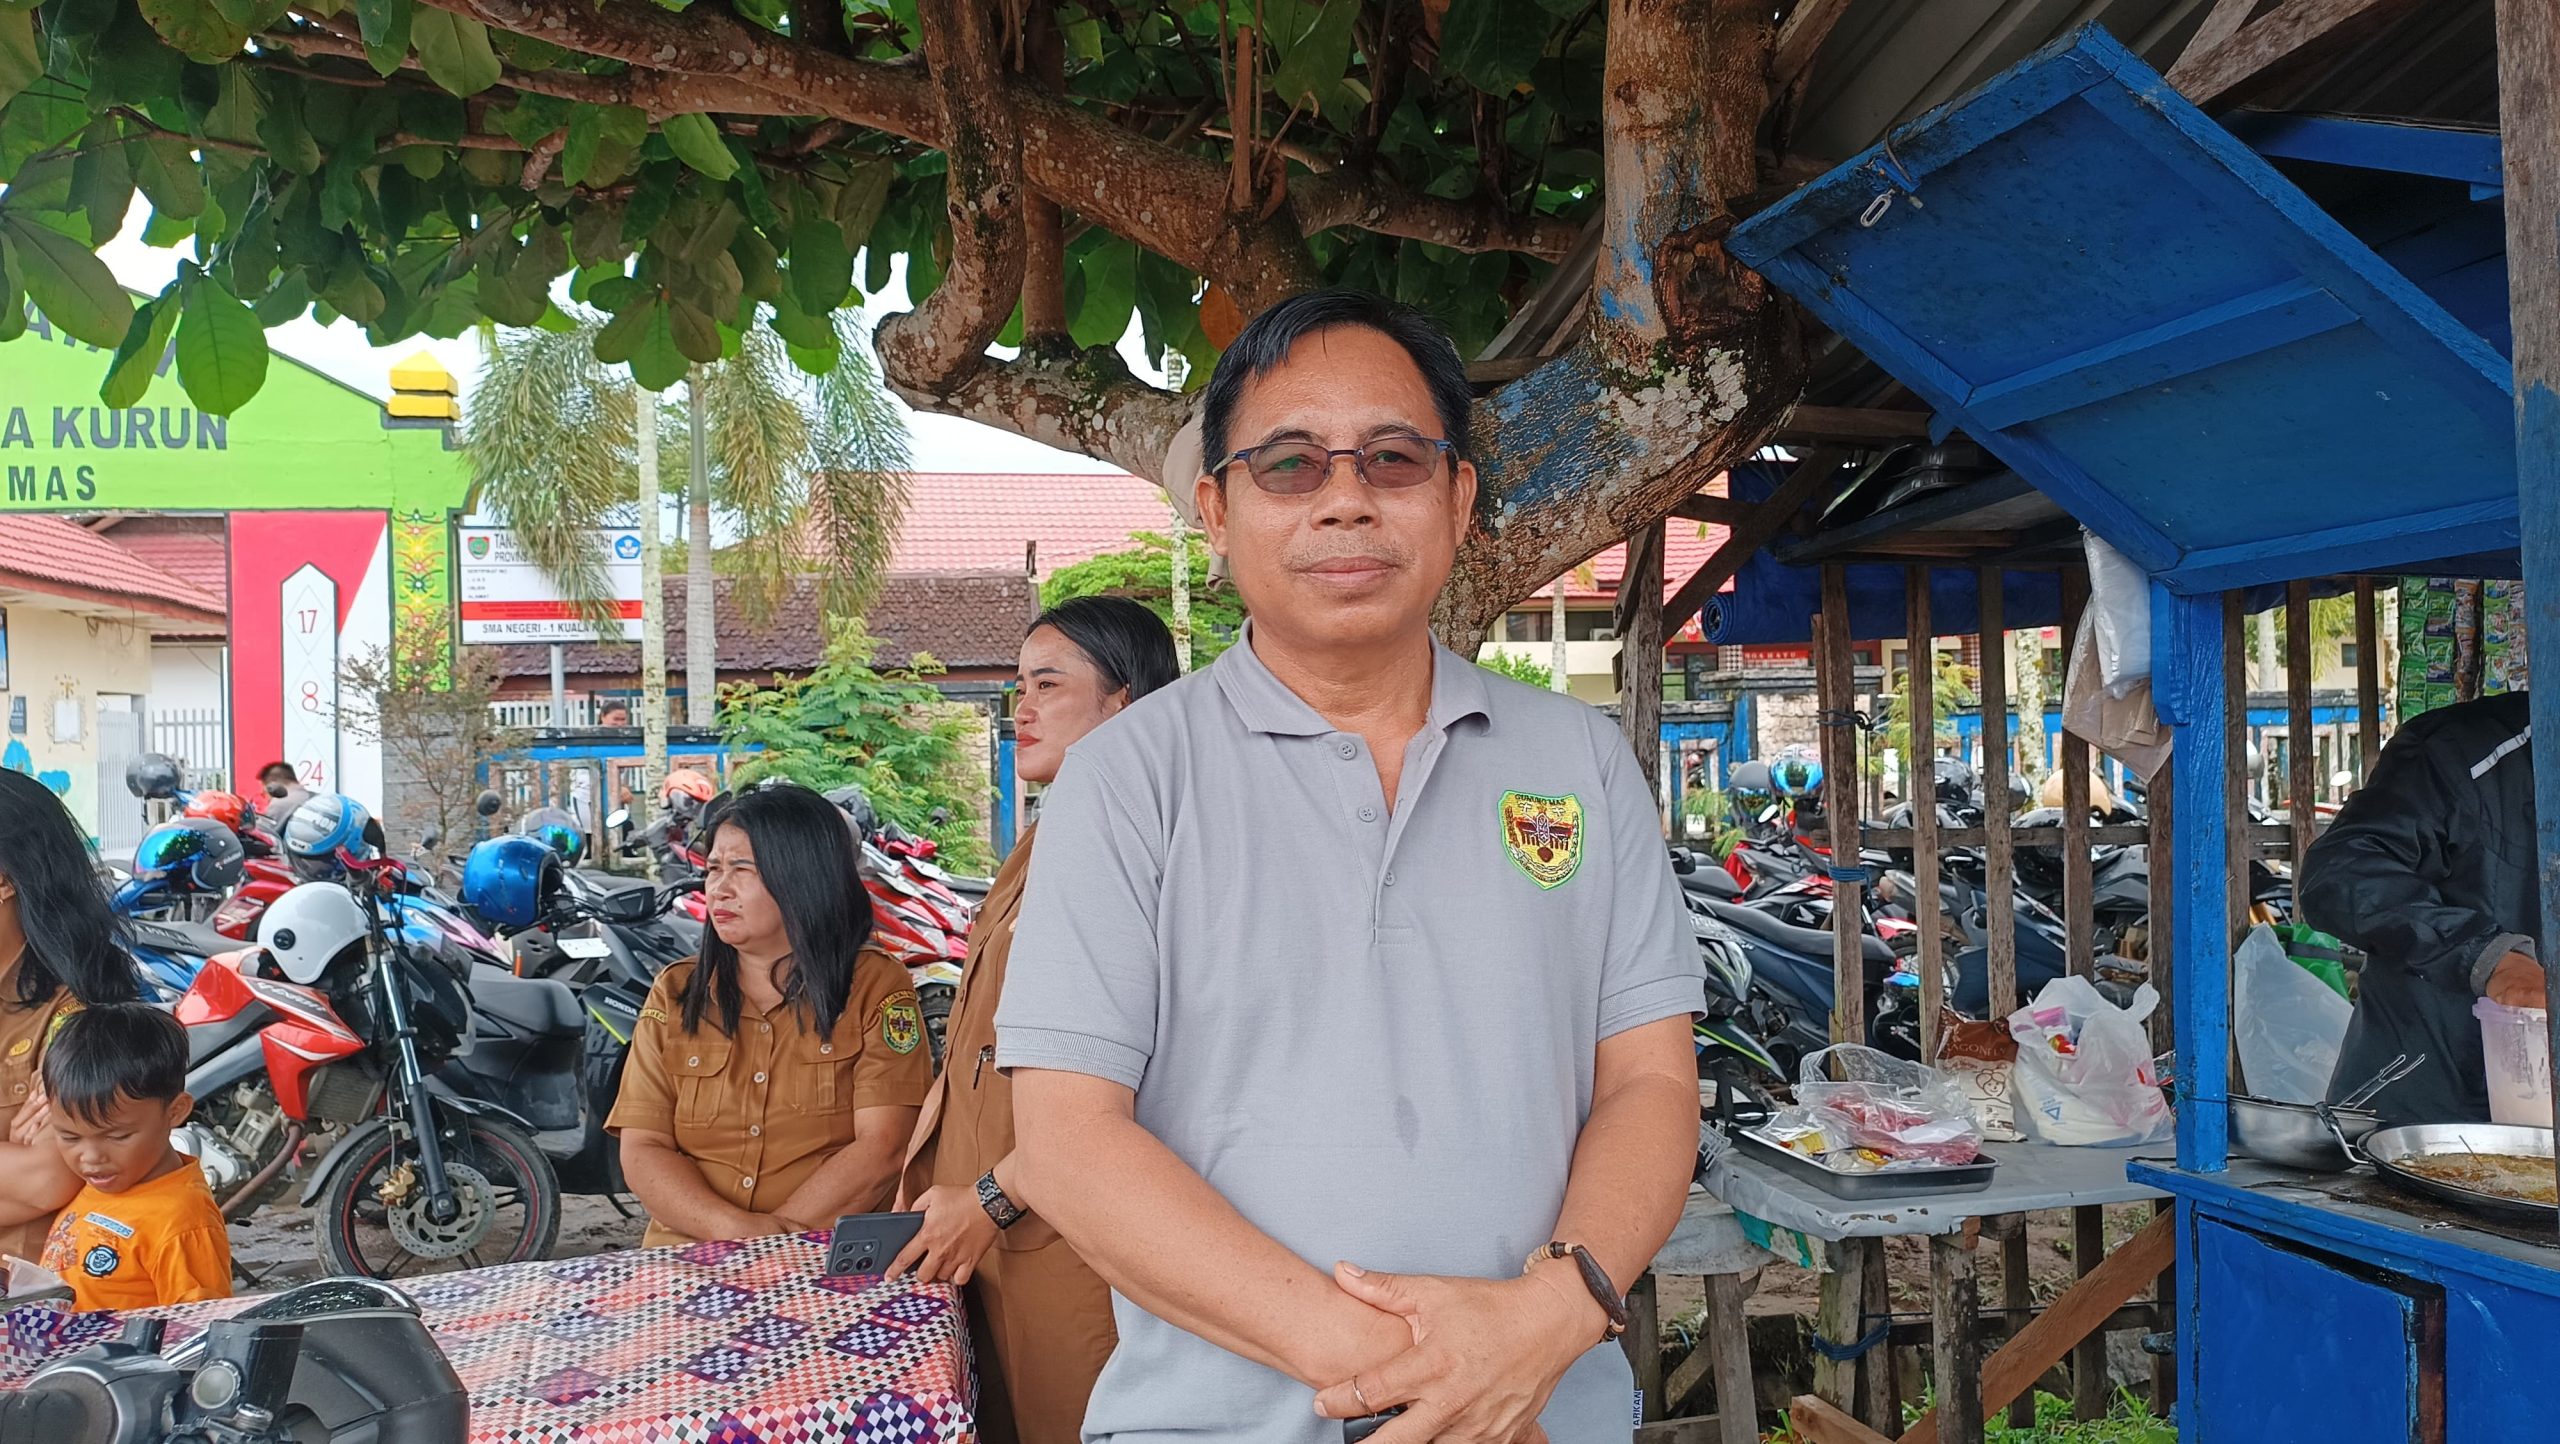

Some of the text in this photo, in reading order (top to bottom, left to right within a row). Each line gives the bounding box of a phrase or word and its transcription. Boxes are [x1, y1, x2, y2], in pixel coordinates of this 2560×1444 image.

[53, 406, 228, 450] KURUN
[8, 465, 96, 501] MAS
[494, 533, 519, 549] TANA
[494, 551, 528, 562] PROVINS
[298, 609, 317, 633] 17
[482, 624, 503, 633] SMA
[505, 623, 541, 633] NEGERI
[558, 622, 589, 633] KUALA
[302, 681, 318, 712] 8
[298, 760, 323, 786] 24
[604, 996, 637, 1016] HONDA
[1947, 1042, 2007, 1057] AGONFLY
[1632, 1390, 1642, 1426] ARKAN
